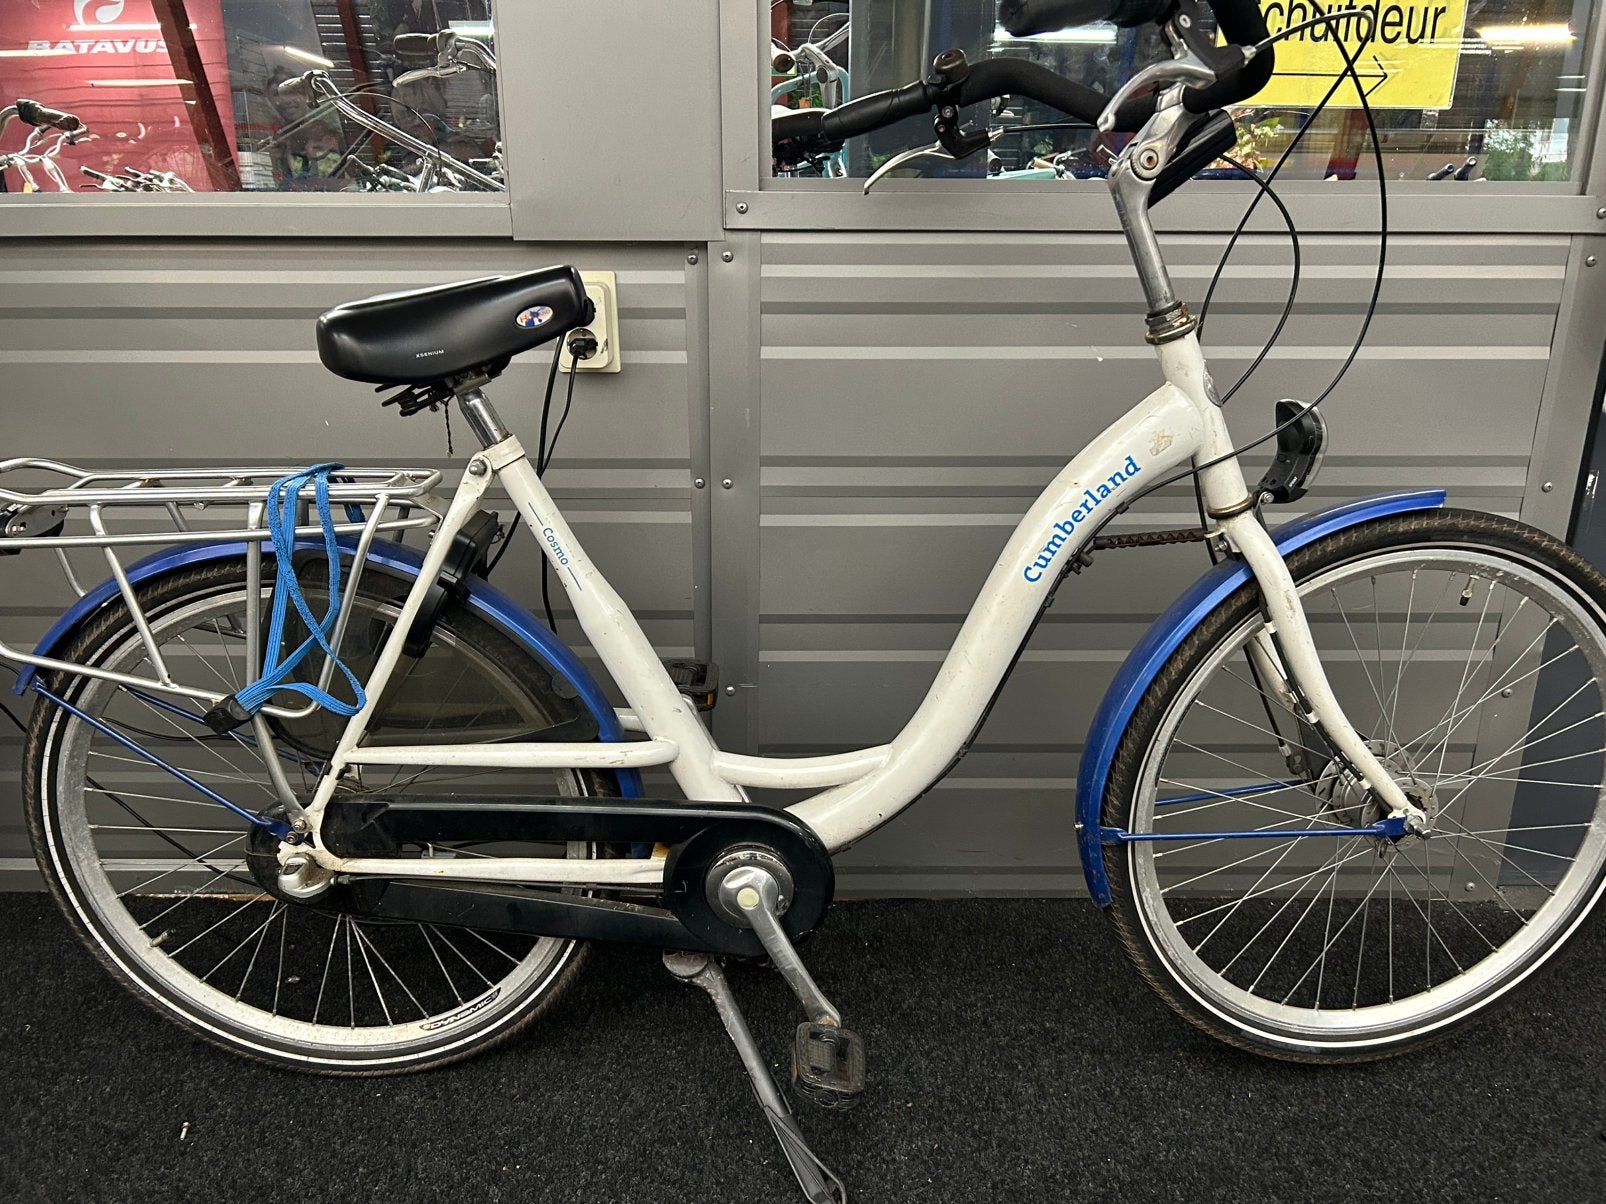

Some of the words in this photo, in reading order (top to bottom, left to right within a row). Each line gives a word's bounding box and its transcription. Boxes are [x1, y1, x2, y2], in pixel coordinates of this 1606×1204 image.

[1258, 0, 1447, 44] chuifdeur
[1023, 455, 1141, 583] Cumberland
[543, 527, 568, 565] Cosmo
